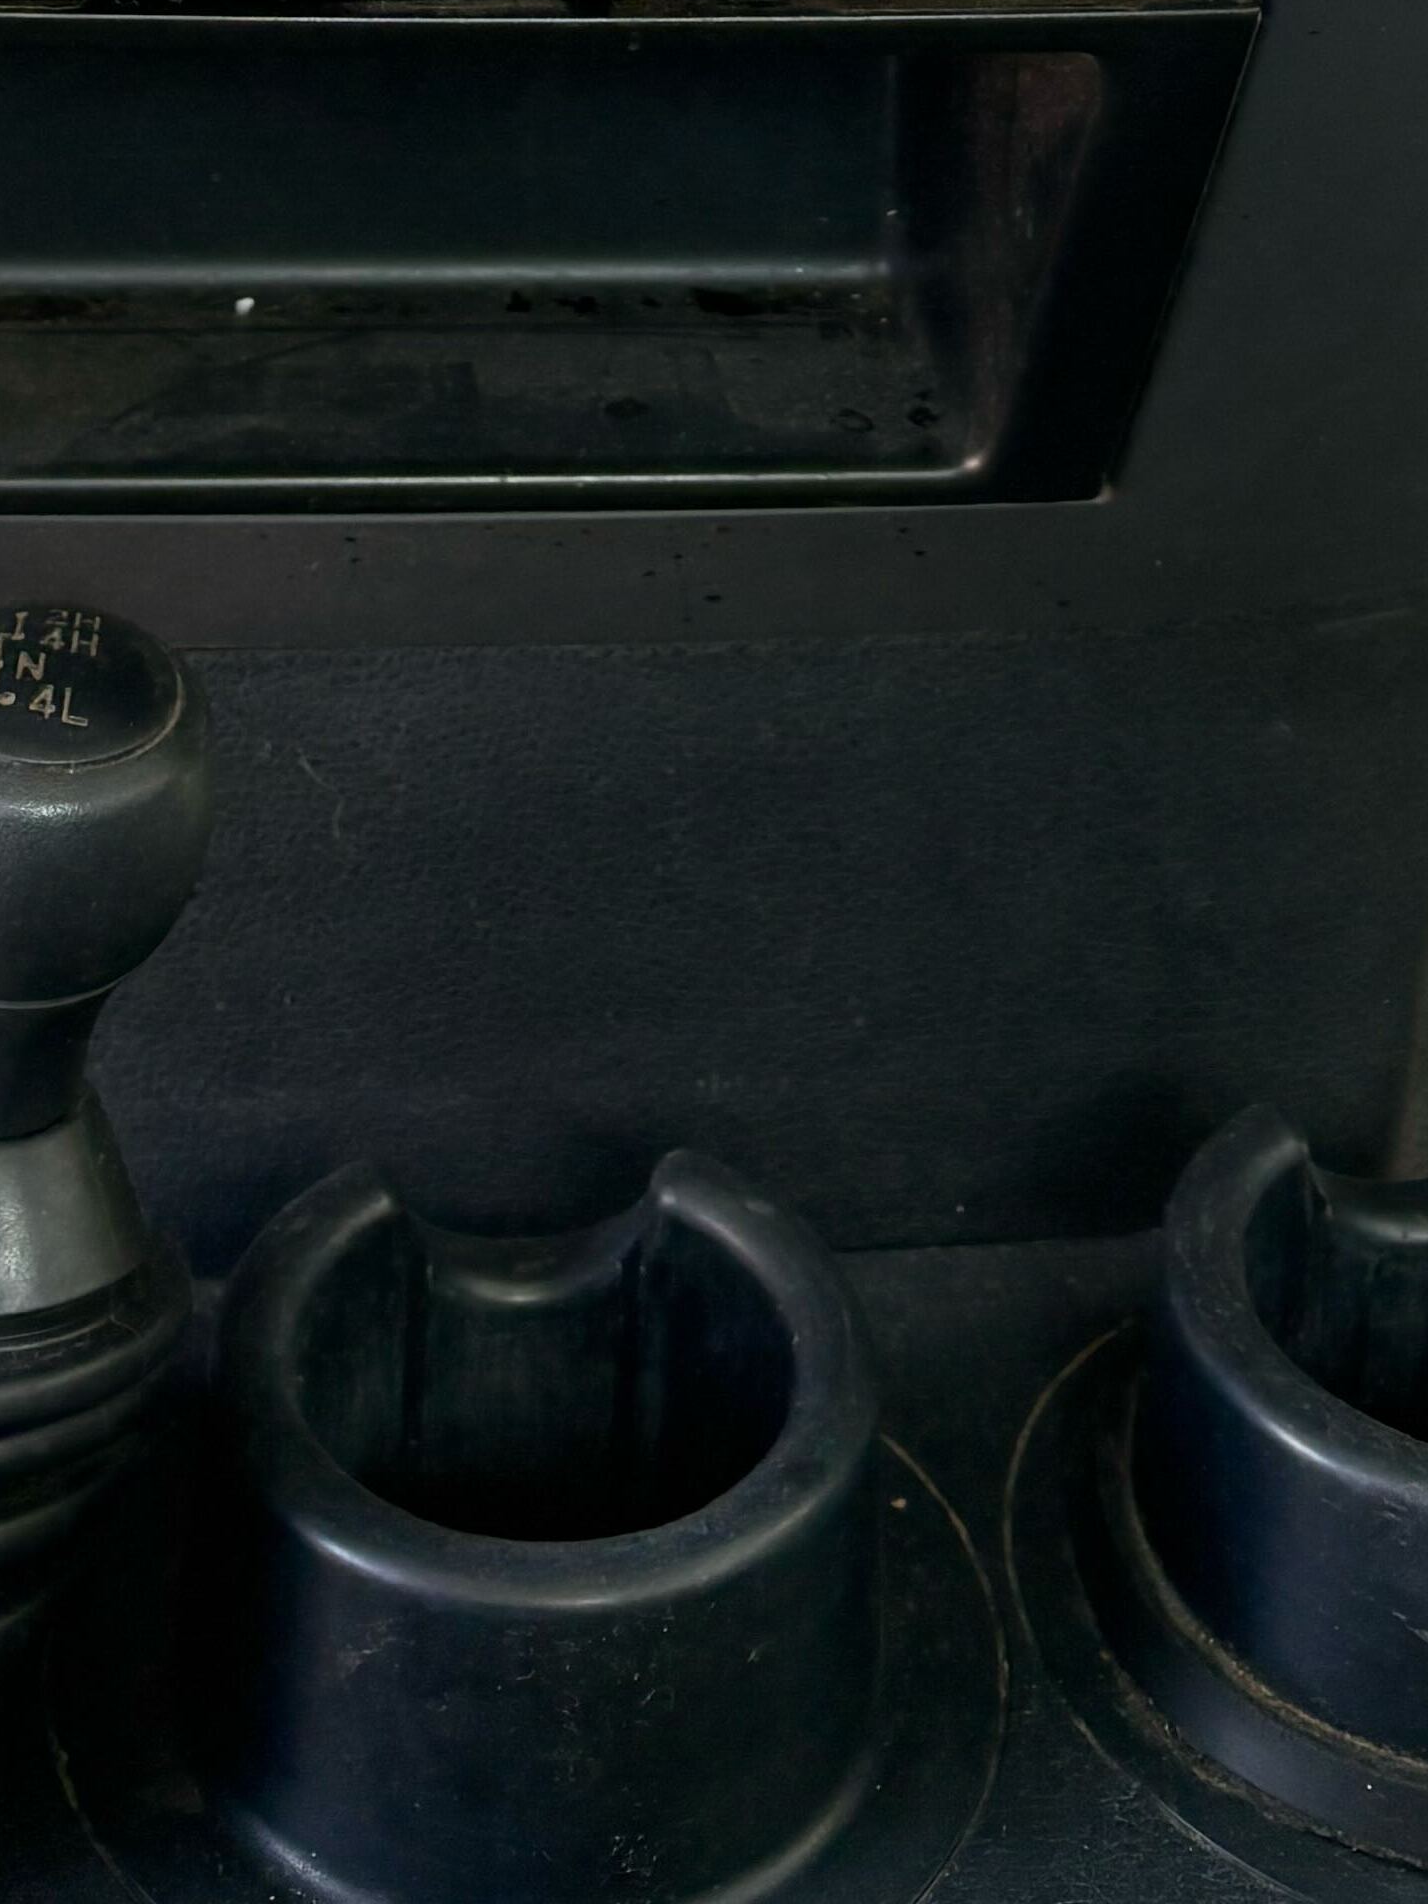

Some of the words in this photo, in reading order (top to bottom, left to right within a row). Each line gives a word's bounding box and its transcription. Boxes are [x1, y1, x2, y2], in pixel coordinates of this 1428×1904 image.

[39, 627, 100, 657] 4H
[15, 650, 47, 681] N
[29, 684, 89, 727] 4L
